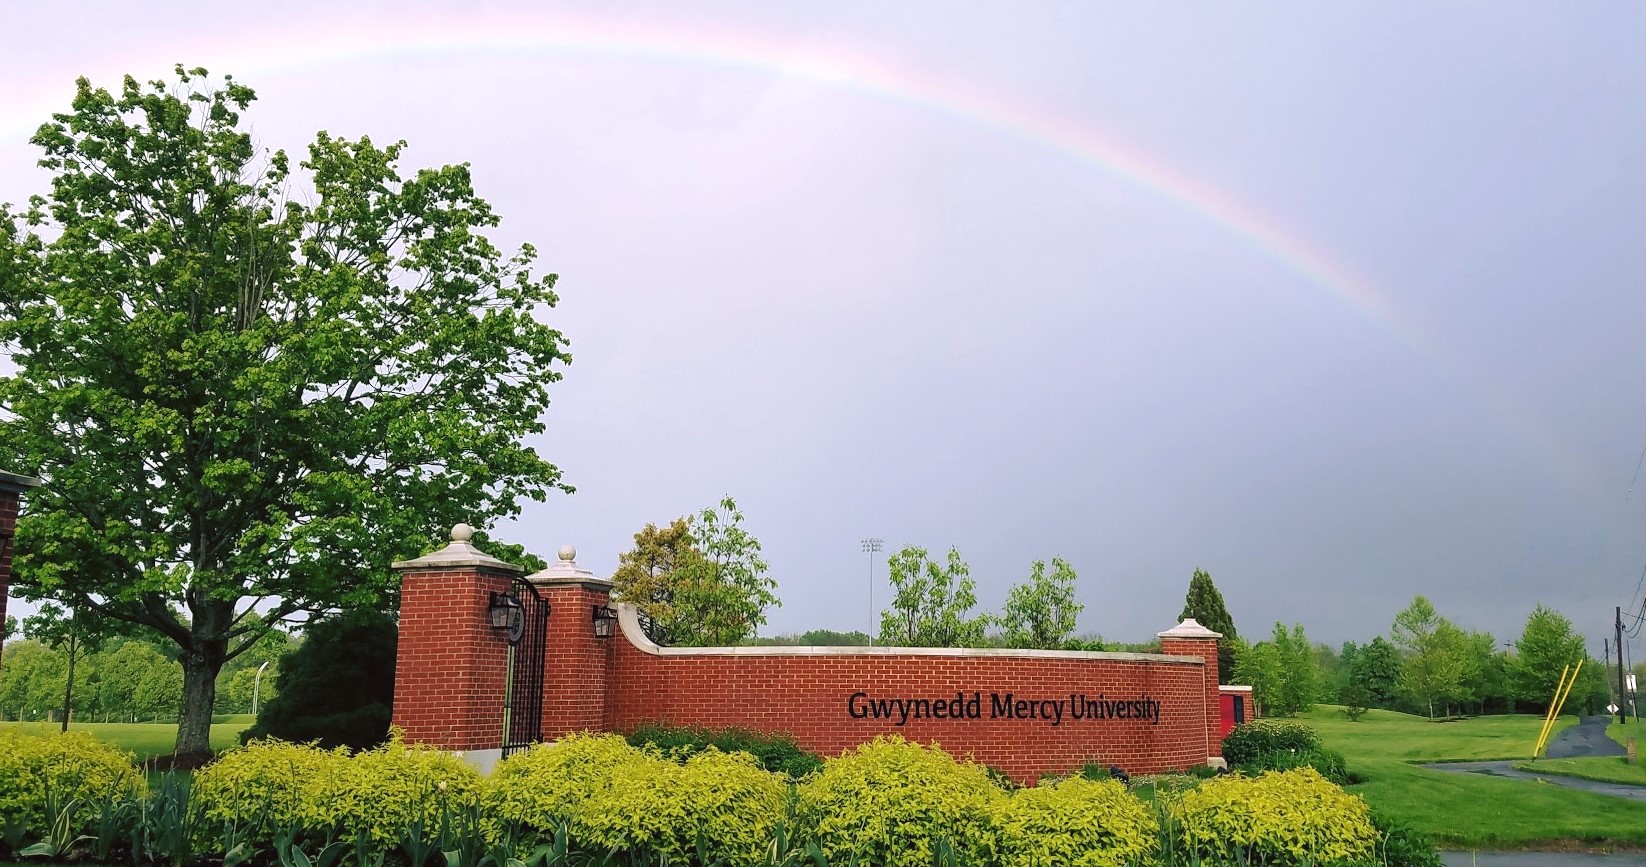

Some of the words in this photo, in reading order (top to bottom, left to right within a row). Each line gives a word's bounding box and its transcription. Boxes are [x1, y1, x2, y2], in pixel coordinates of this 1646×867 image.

[848, 691, 981, 726] Gwynedd
[990, 693, 1065, 726] Mercy
[1070, 694, 1161, 726] University
